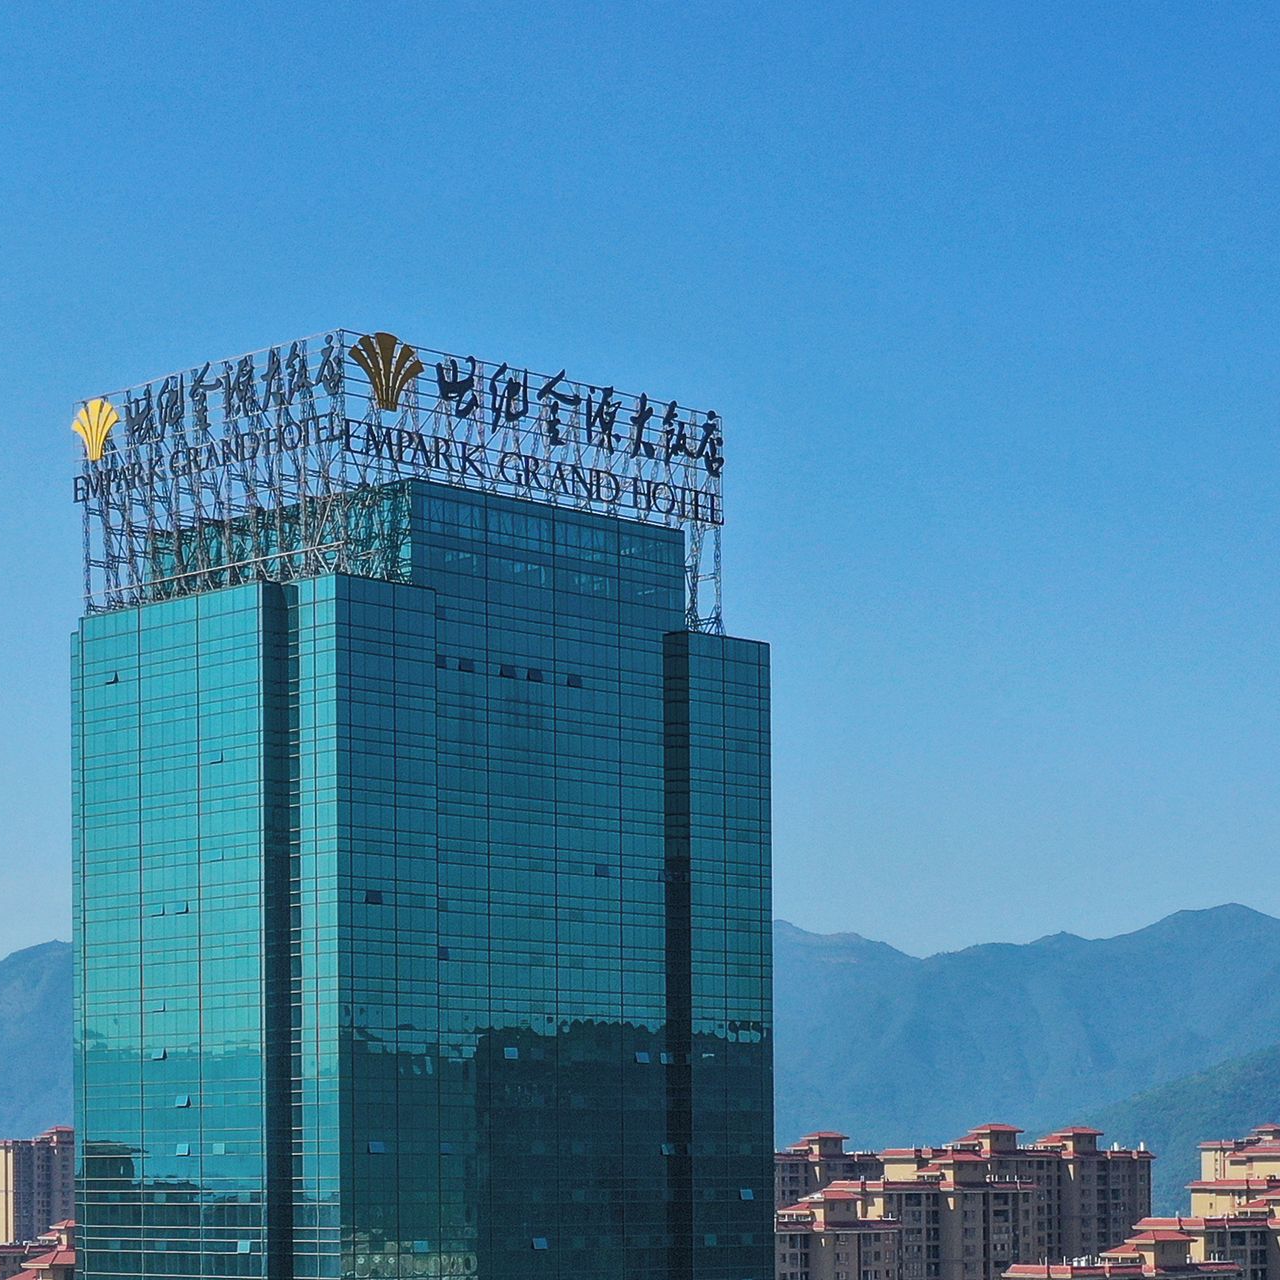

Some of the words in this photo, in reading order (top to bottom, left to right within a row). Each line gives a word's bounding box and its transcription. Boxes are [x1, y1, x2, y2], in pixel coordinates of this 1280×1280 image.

[73, 455, 167, 503] EMPARK
[170, 432, 261, 479] GRAND
[266, 411, 344, 454] HOTEL
[343, 419, 484, 479] EMPARK
[500, 451, 620, 502] GRAND
[633, 477, 724, 525] HOTEL
